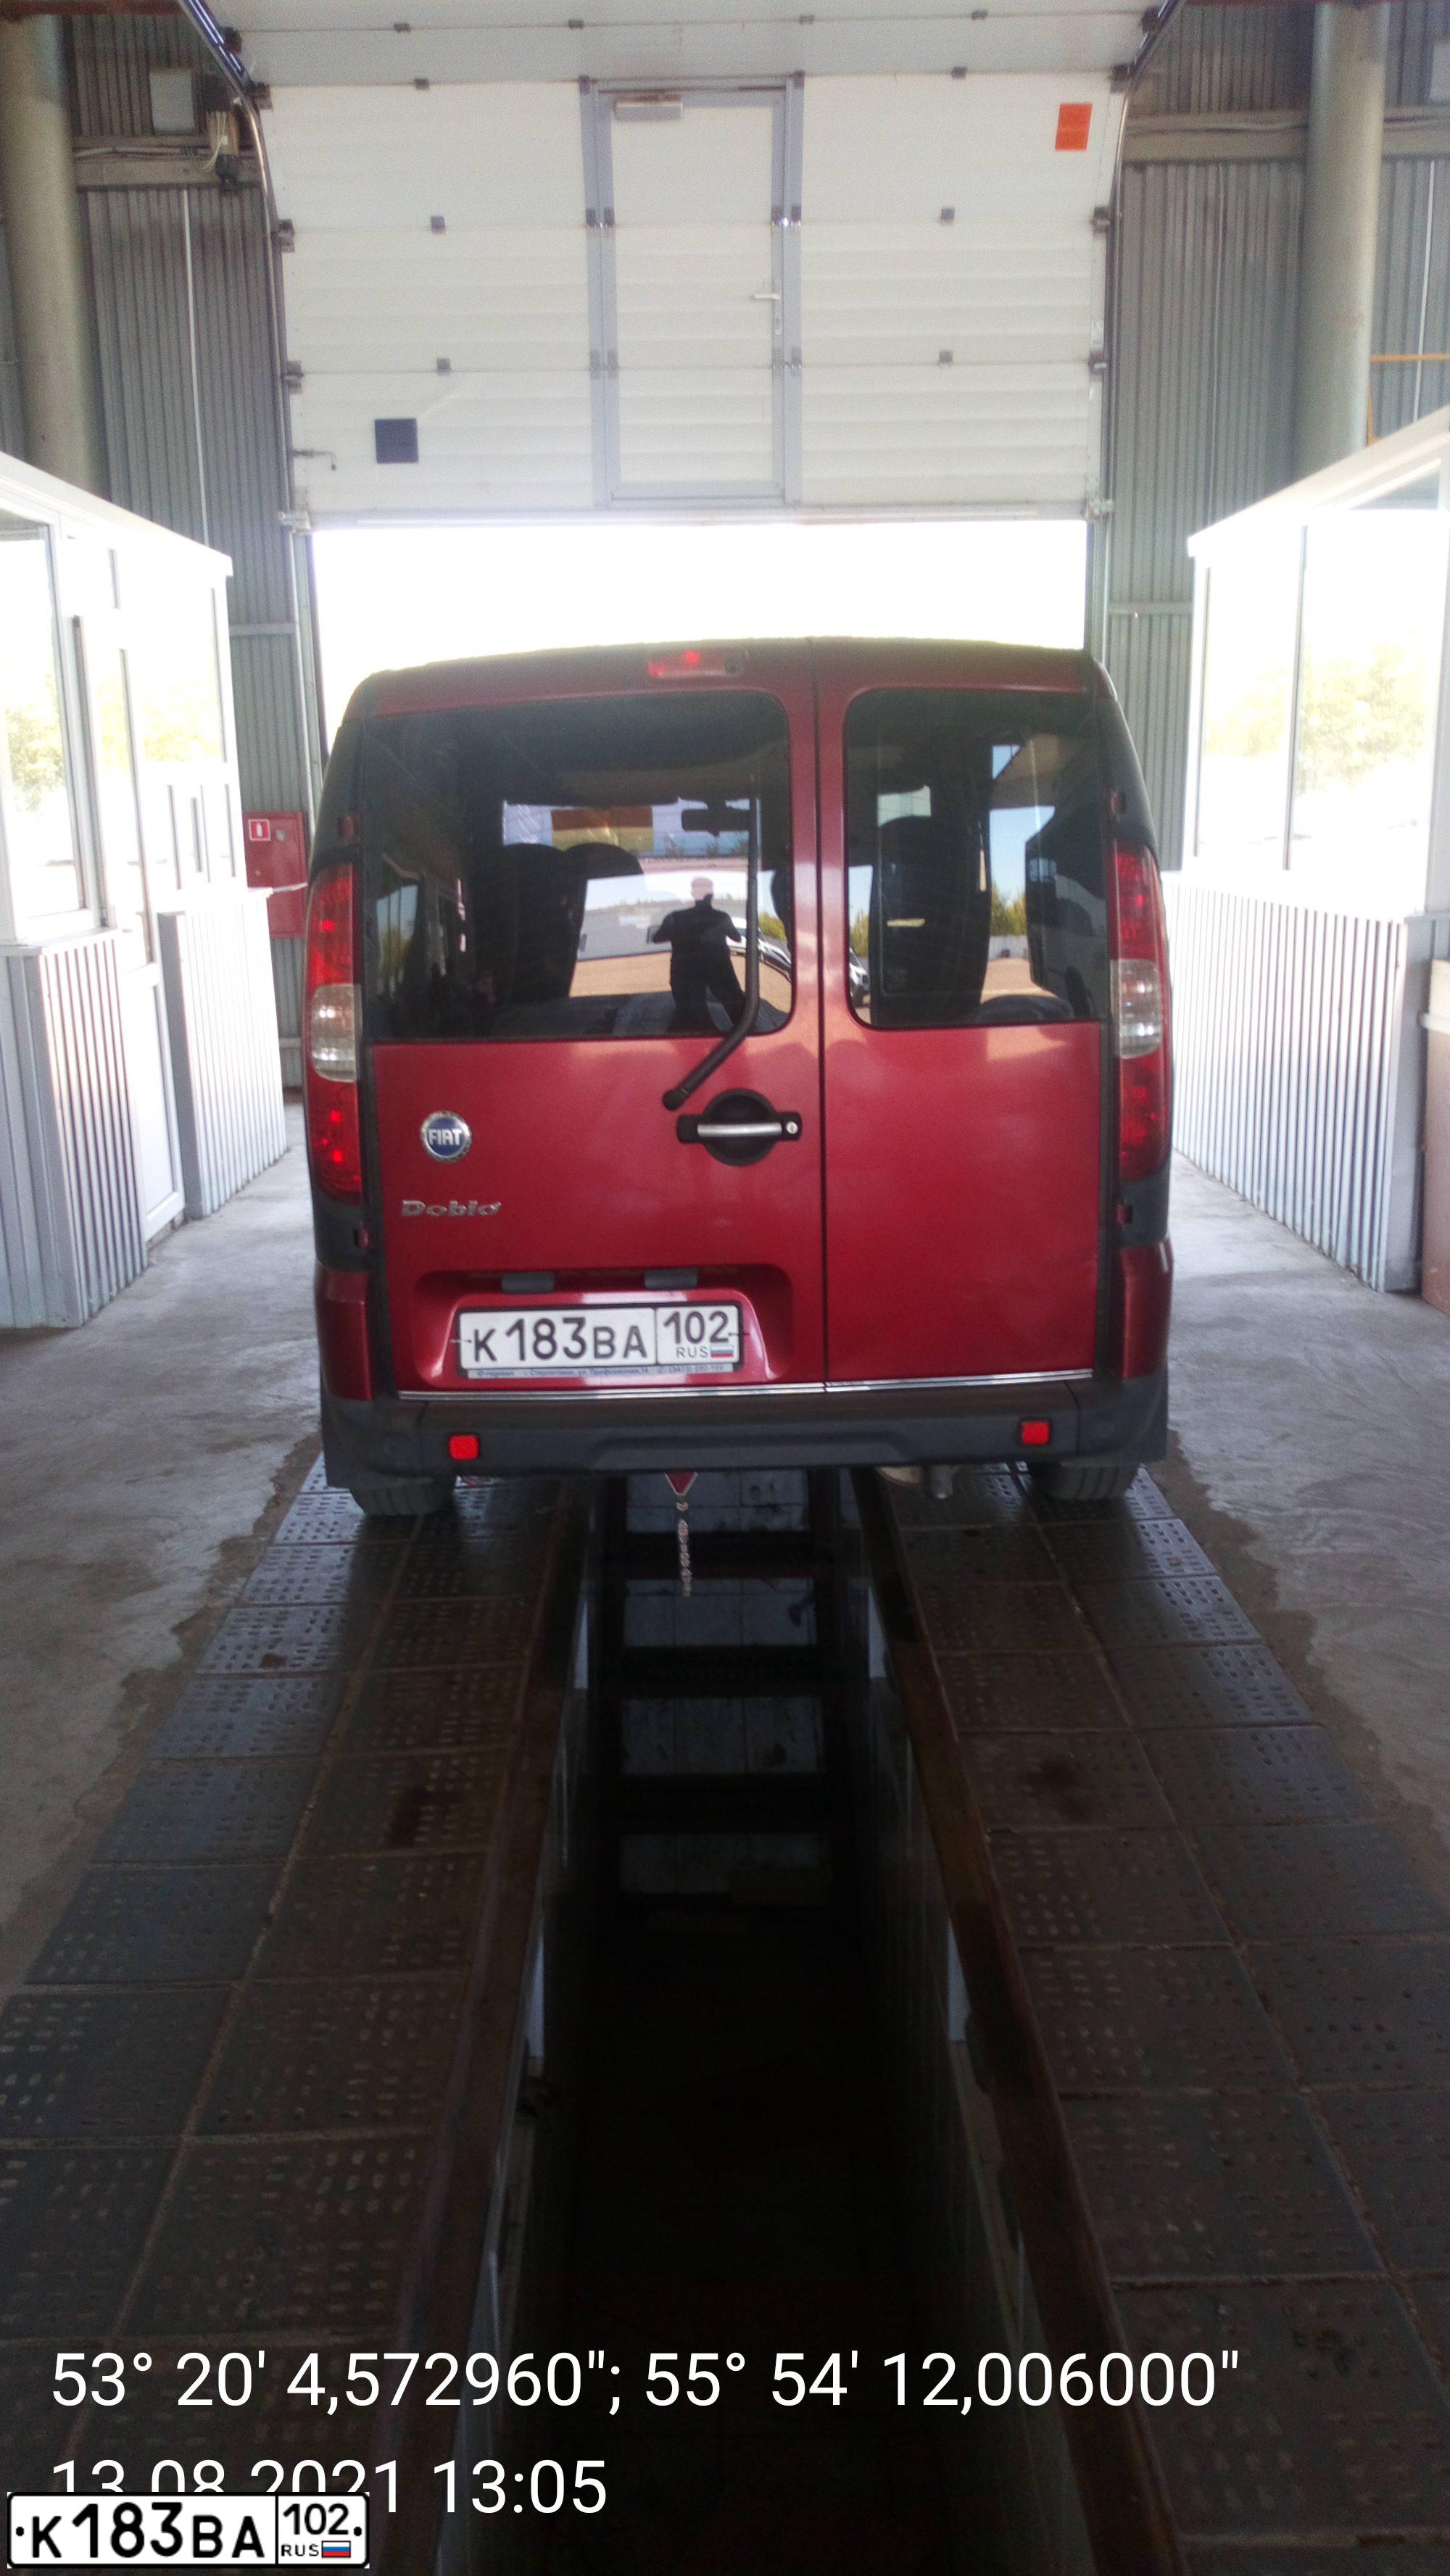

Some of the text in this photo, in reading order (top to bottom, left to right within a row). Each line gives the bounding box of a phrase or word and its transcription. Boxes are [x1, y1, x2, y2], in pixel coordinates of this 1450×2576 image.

[428, 1128, 463, 1146] FIAT
[663, 1310, 730, 1345] 102
[676, 1346, 708, 1359] RUS
